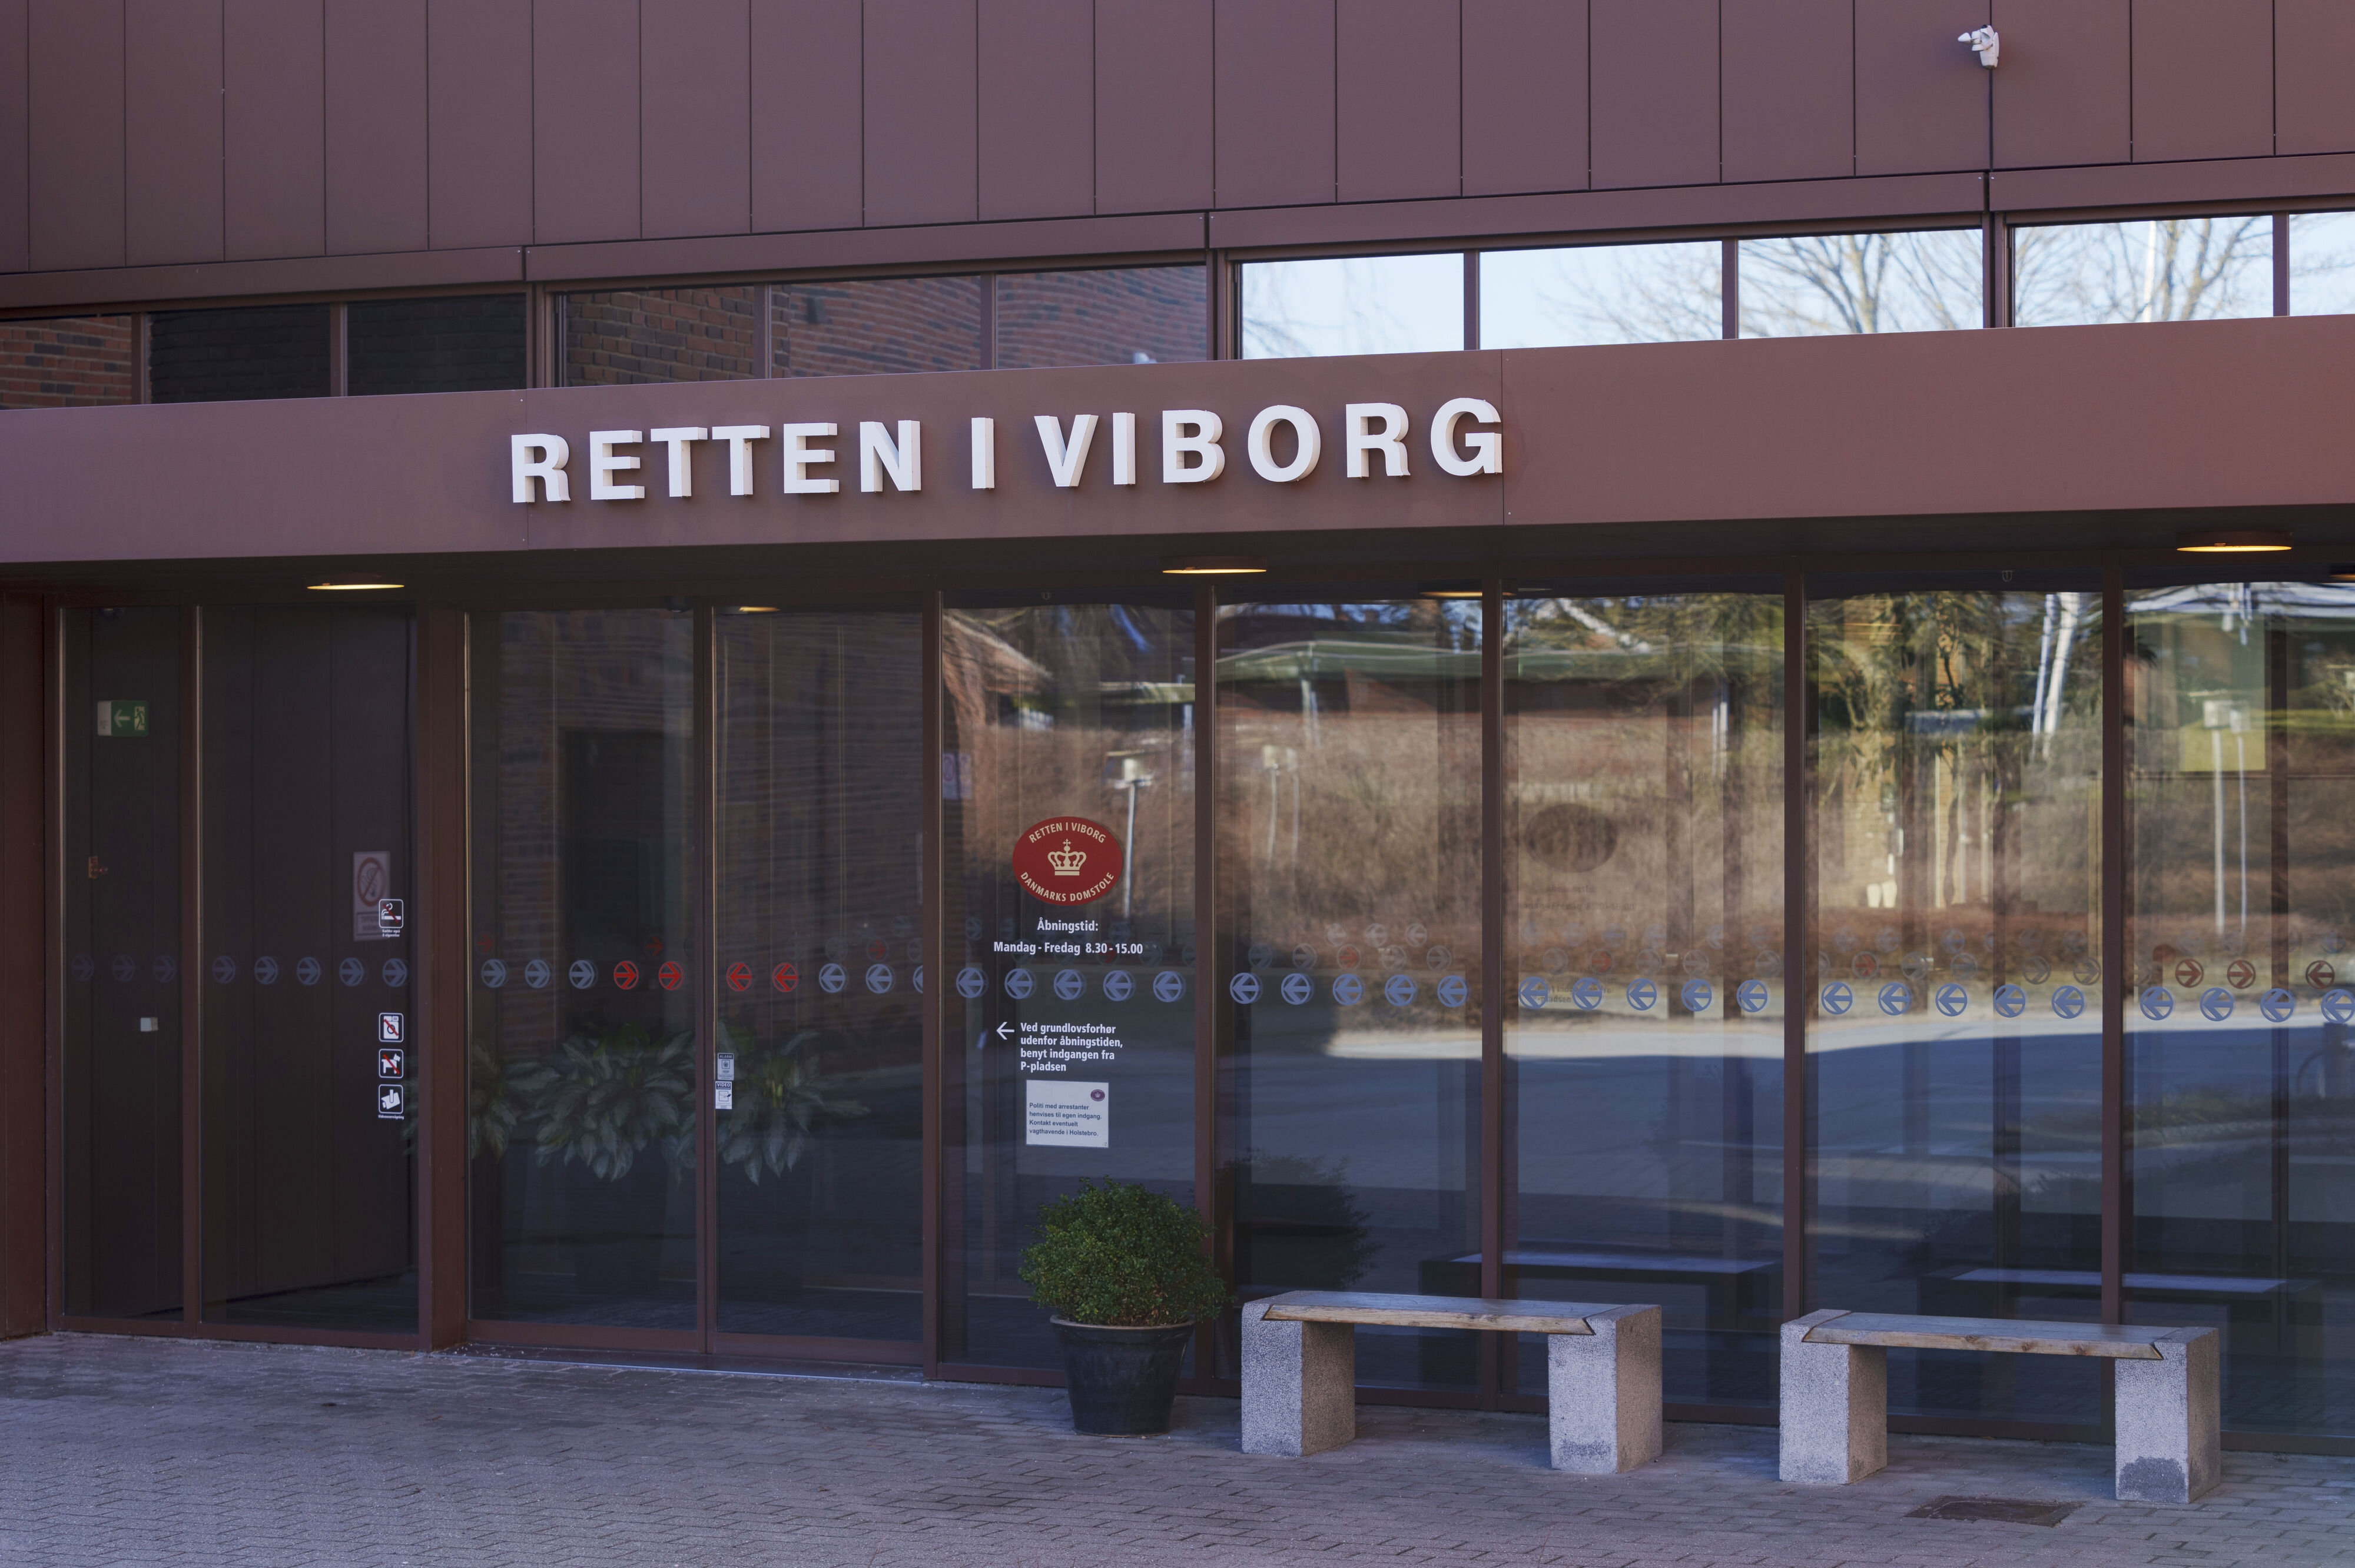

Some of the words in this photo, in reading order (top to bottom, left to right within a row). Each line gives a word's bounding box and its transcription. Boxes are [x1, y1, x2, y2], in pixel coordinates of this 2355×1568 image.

[511, 420, 921, 503] RETTEN
[971, 417, 995, 489] I
[1033, 397, 1502, 487] VIBORG
[1029, 822, 1063, 843] RETTEN
[1066, 822, 1069, 831] I
[1071, 822, 1106, 843] VIBORG
[1020, 872, 1067, 902] DANMARKS
[1070, 872, 1115, 902] DOMSTOLE
[1037, 917, 1099, 934] Åbningstid:
[994, 942, 1036, 955] Mandag
[1044, 942, 1080, 955] Fredag
[1085, 942, 1107, 954] 8.30
[1115, 944, 1143, 954] 15.00
[1020, 1022, 1038, 1032] Ved
[1040, 1023, 1116, 1035] grundlovsforhør
[1020, 1035, 1057, 1045] udenfor
[1059, 1036, 1123, 1049] åbningstiden,
[1020, 1048, 1047, 1060] benyt
[1050, 1049, 1099, 1061] indgangen
[1101, 1050, 1115, 1060] fra
[1020, 1061, 1067, 1073] P-pladsen
